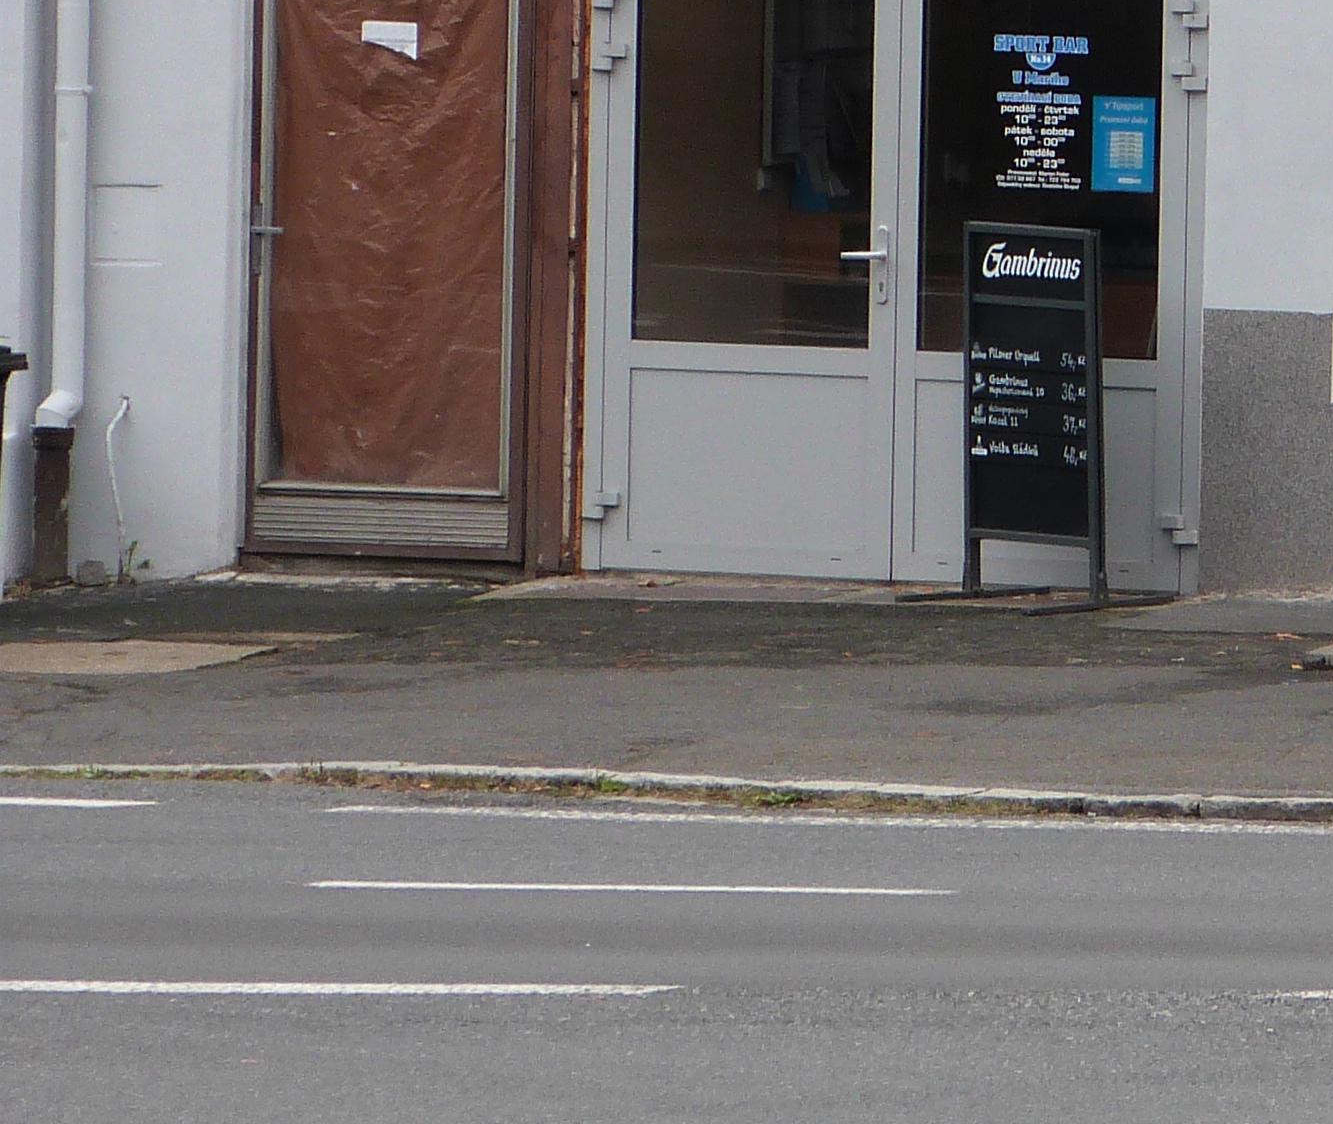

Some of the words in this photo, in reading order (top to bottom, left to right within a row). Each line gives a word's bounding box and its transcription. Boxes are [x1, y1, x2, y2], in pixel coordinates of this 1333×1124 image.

[994, 34, 1050, 53] SPORT
[1052, 36, 1088, 55] BAR
[1001, 104, 1036, 115] pondělí
[1044, 105, 1079, 115] čtvrtek
[1004, 125, 1033, 136] pátek
[1040, 127, 1075, 136] sobota
[1023, 148, 1056, 157] neděle
[982, 242, 1081, 280] Gambrinus
